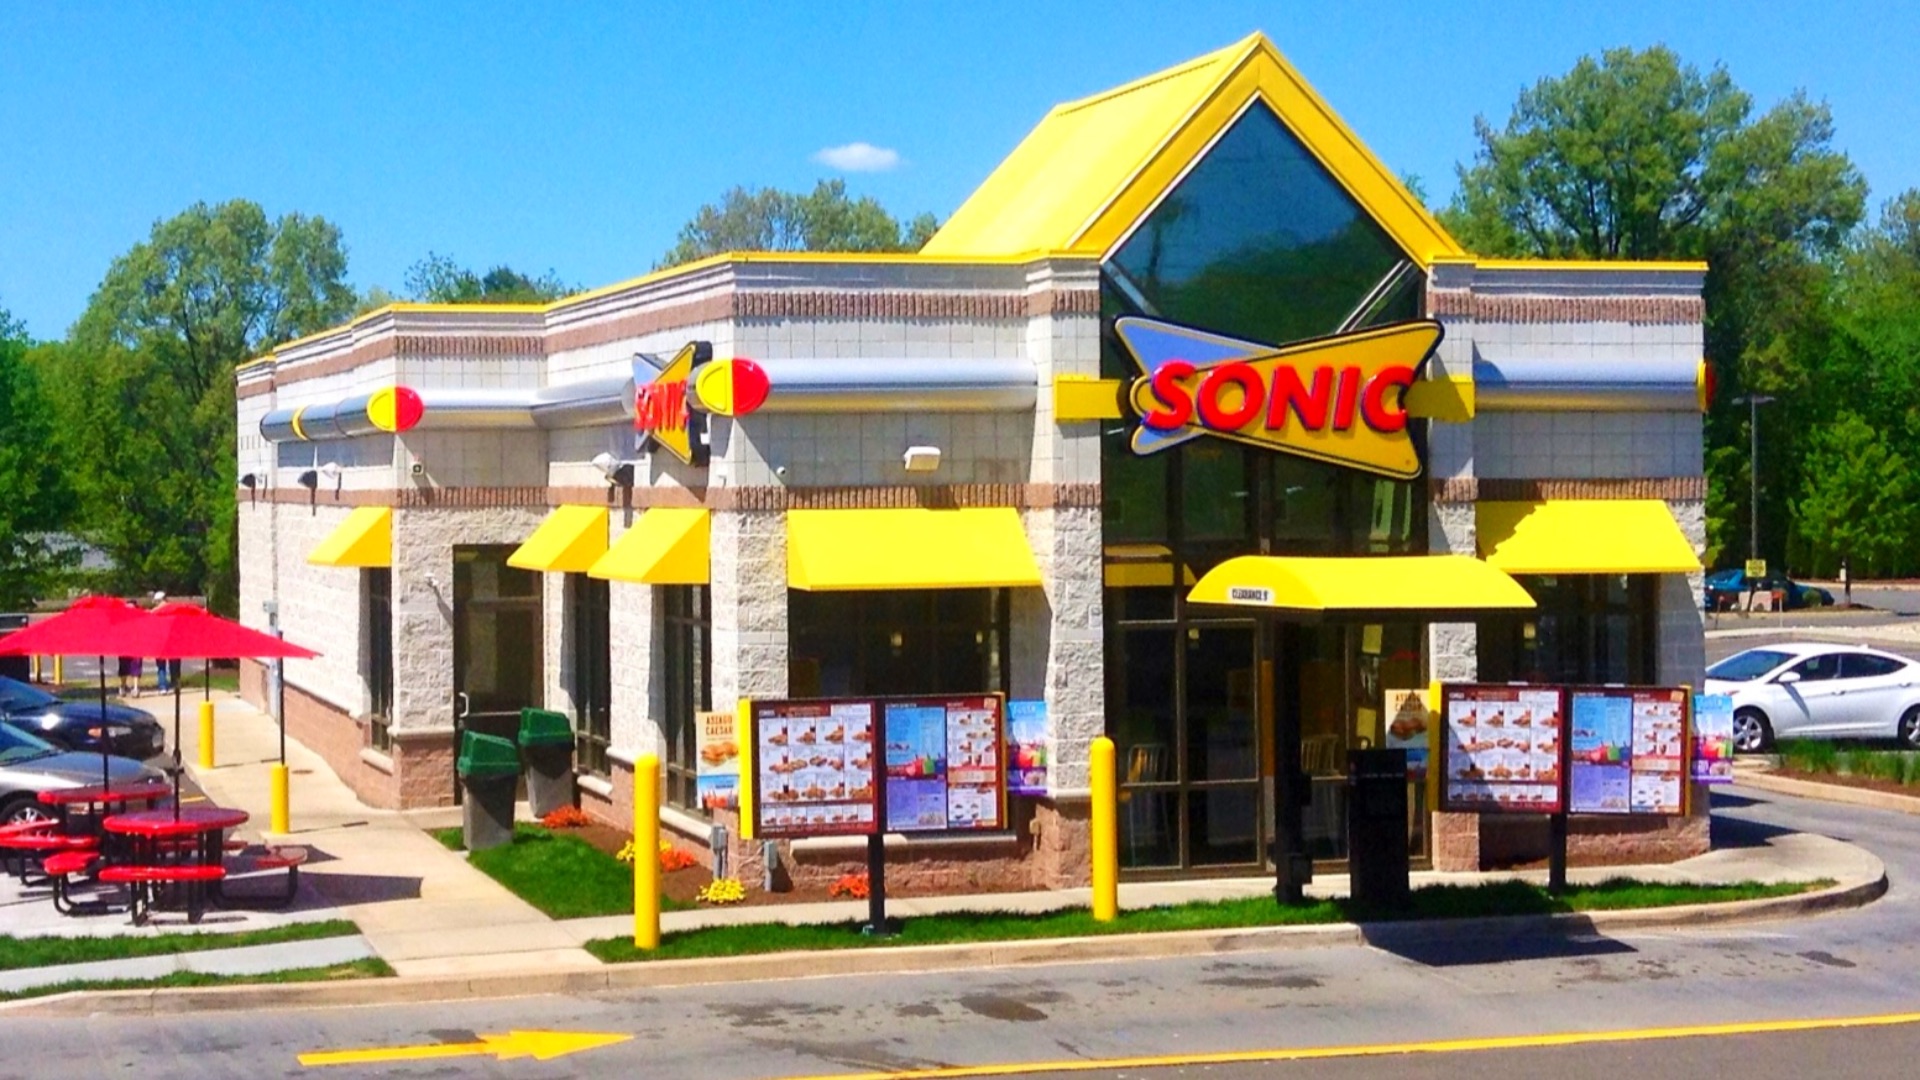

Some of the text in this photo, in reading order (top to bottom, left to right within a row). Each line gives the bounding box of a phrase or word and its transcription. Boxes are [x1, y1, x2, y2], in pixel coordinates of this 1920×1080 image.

[633, 381, 690, 432] SONIC
[1145, 360, 1415, 432] SONIC
[705, 726, 733, 736] CAESAR
